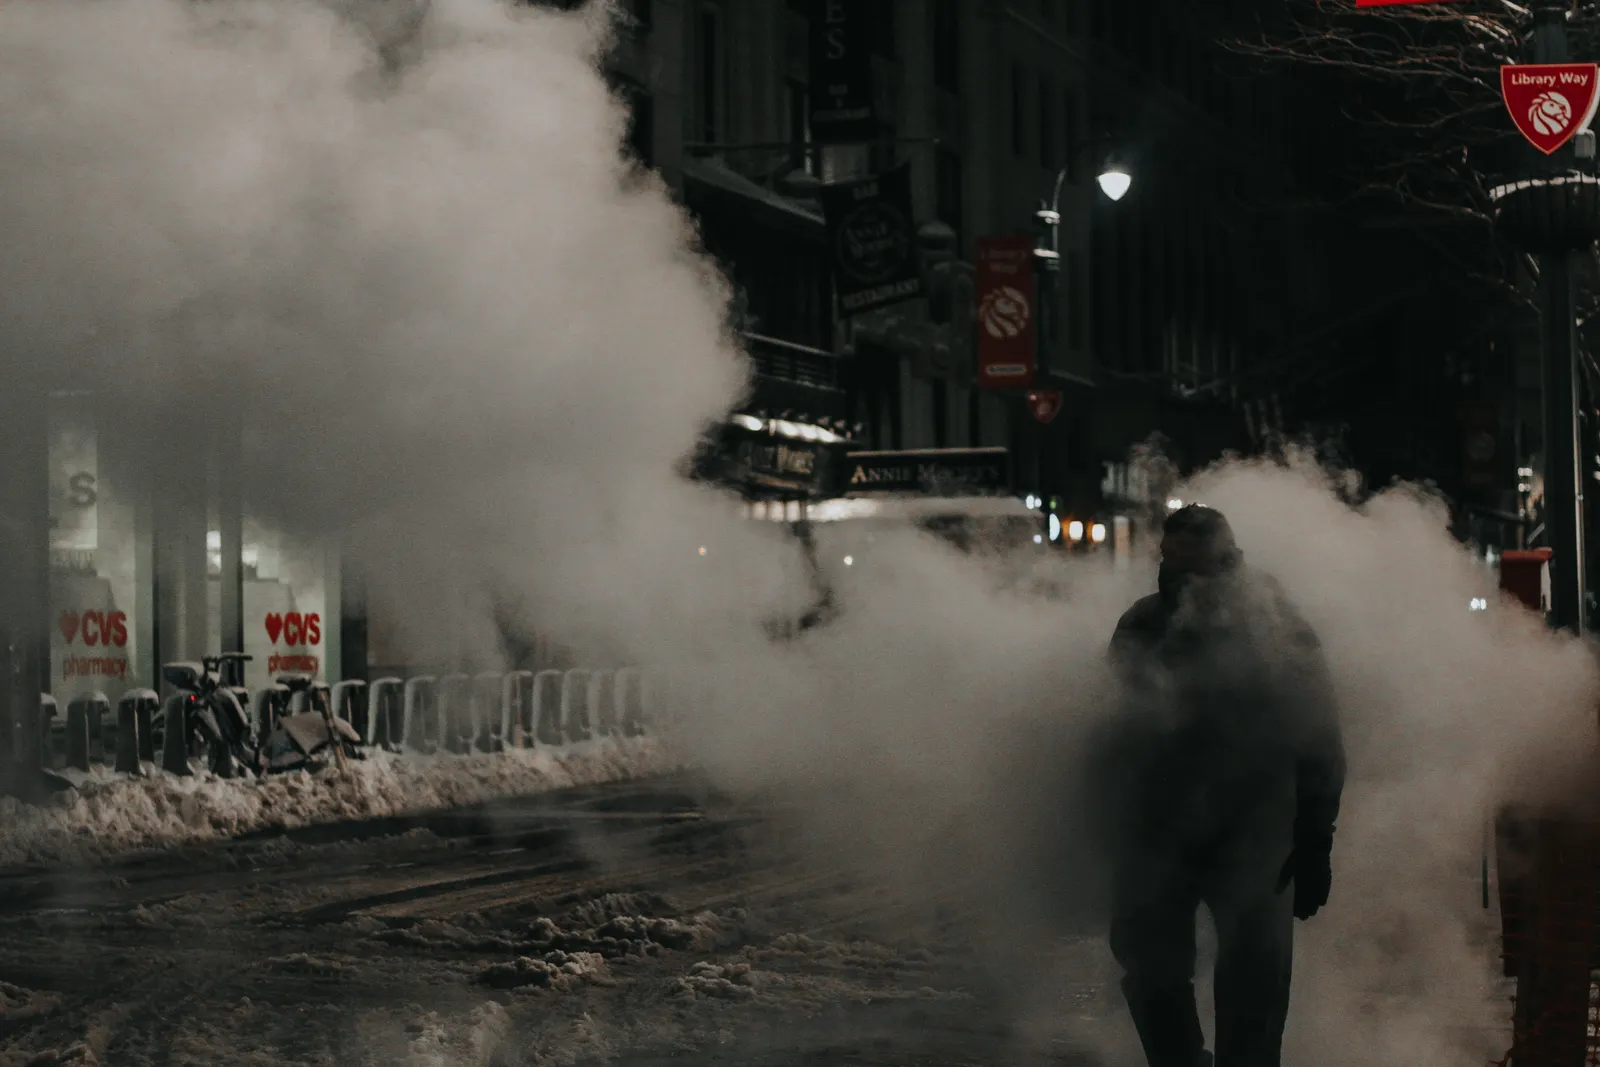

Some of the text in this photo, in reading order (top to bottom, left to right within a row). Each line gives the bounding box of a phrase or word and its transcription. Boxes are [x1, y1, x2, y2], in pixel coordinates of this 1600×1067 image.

[1511, 72, 1588, 88] Library Way
[81, 610, 128, 648] CVS
[283, 611, 321, 648] CVS
[62, 656, 127, 681] pharmacy
[266, 652, 319, 678] pharmacy
